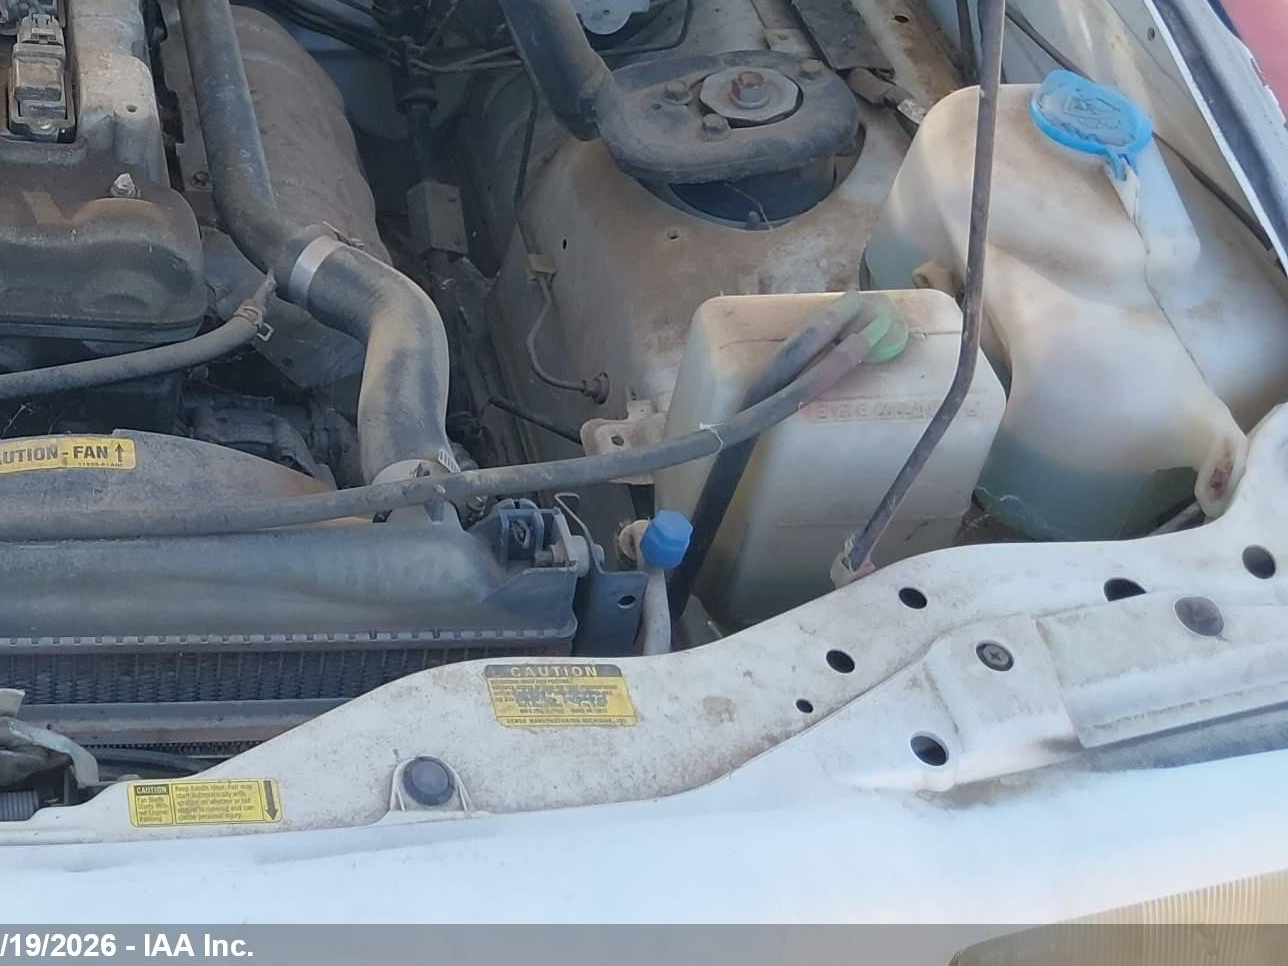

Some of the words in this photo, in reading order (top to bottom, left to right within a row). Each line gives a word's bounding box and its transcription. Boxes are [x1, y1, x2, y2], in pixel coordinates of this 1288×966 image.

[73, 445, 109, 460] FAN
[510, 665, 598, 678] CAUTION
[136, 785, 168, 795] CAUTION
